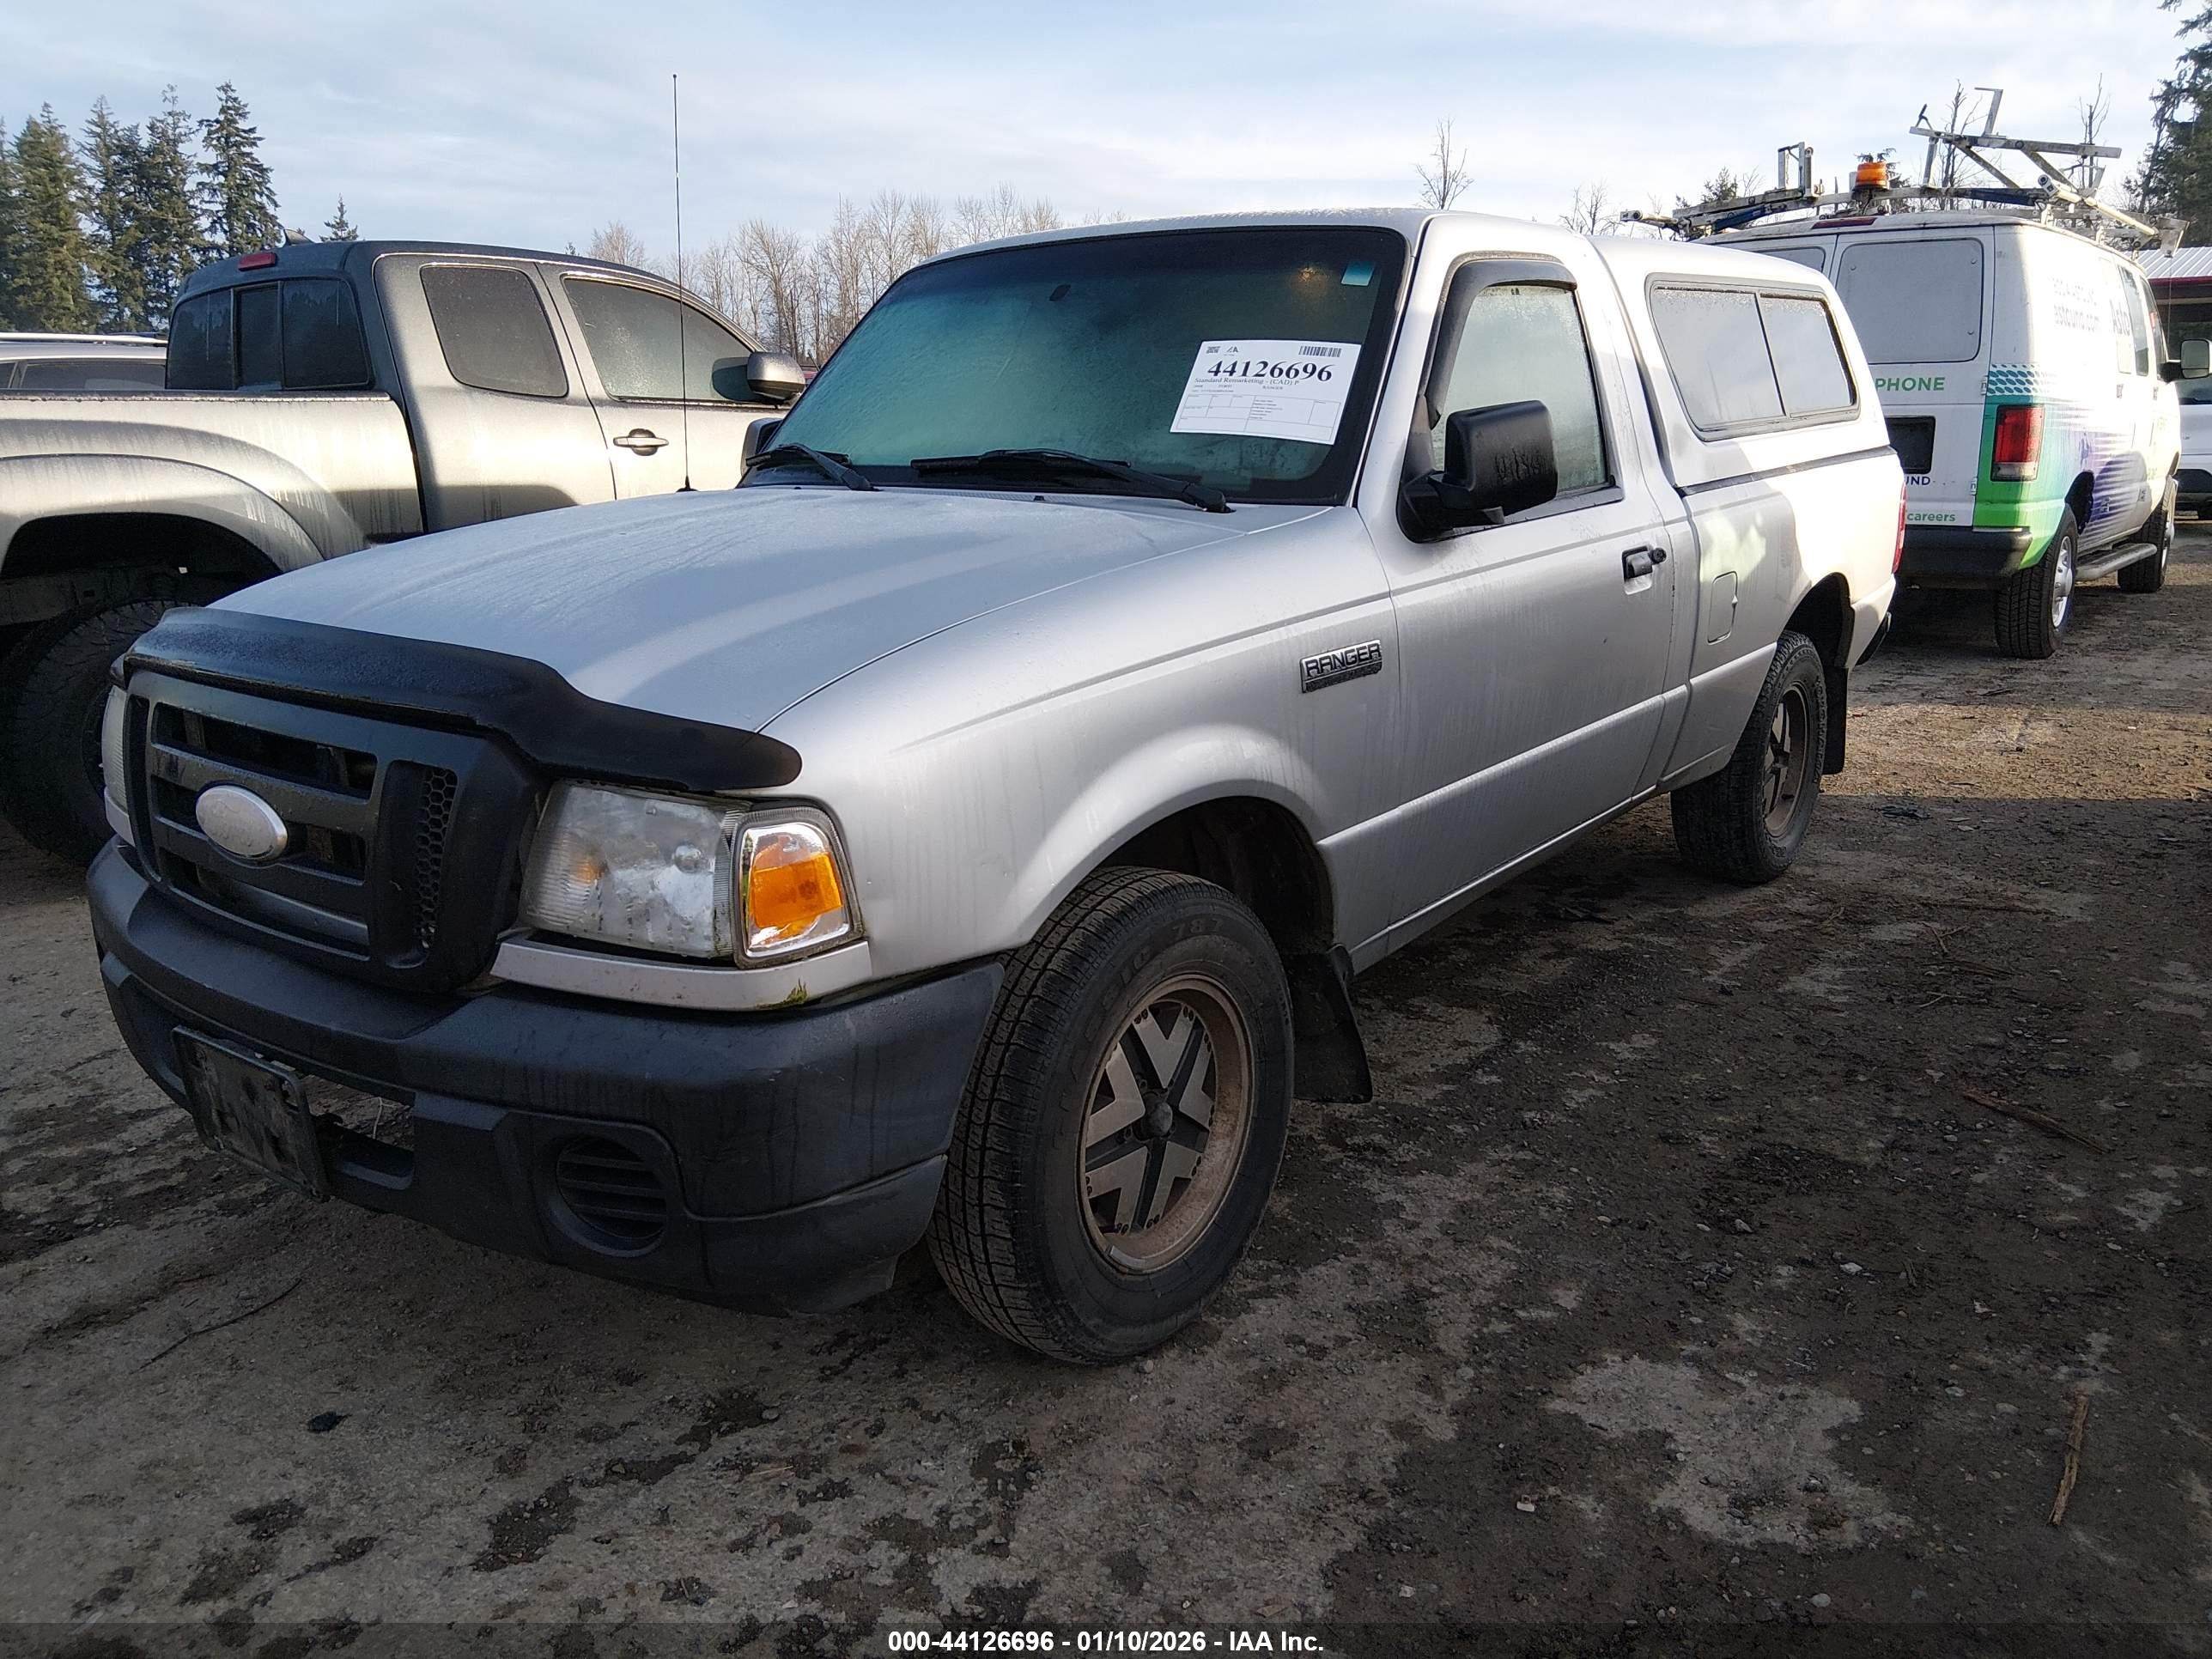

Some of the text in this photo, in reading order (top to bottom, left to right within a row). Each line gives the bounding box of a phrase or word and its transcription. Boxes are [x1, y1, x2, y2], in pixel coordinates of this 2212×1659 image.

[1207, 360, 1334, 382] 44126696
[1875, 377, 1945, 391] PHONE
[1906, 513, 1956, 521] careers
[1304, 642, 1382, 678] RANGER
